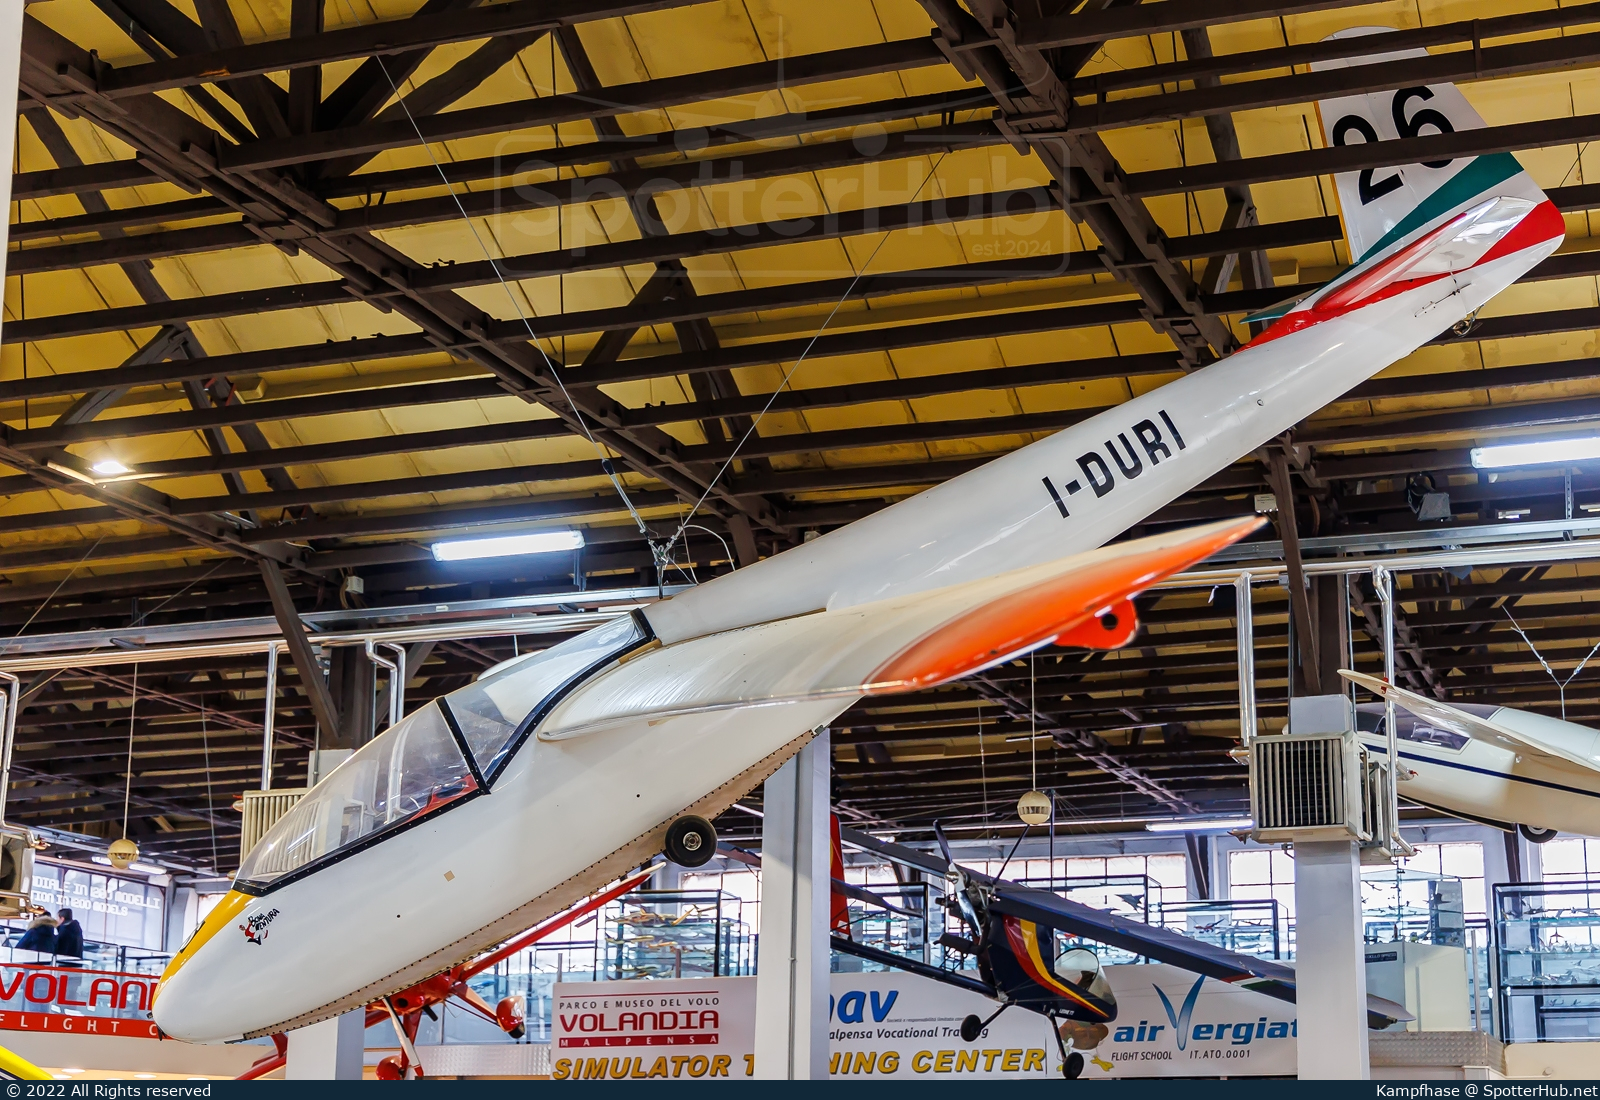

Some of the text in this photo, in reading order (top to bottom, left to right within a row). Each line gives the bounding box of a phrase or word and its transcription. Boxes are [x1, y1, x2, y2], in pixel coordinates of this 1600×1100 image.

[1042, 410, 1186, 518] I-DURI
[0, 971, 157, 1010] VOLAN
[559, 1001, 597, 1010] PARCO
[615, 999, 654, 1008] MUSEO
[660, 998, 682, 1007] DEL
[688, 997, 720, 1006] VOLO
[829, 990, 899, 1024] av
[559, 1010, 719, 1033] VOLANDIA
[561, 1035, 717, 1047] MALPENSA
[829, 1028, 873, 1042] alpensa
[877, 1026, 938, 1039] Vocational
[552, 1054, 731, 1080] SIMULATOR
[911, 1048, 1046, 1074] CENTER
[1111, 1050, 1251, 1061] FLIGHT SCHOOL IT.ATO.0001
